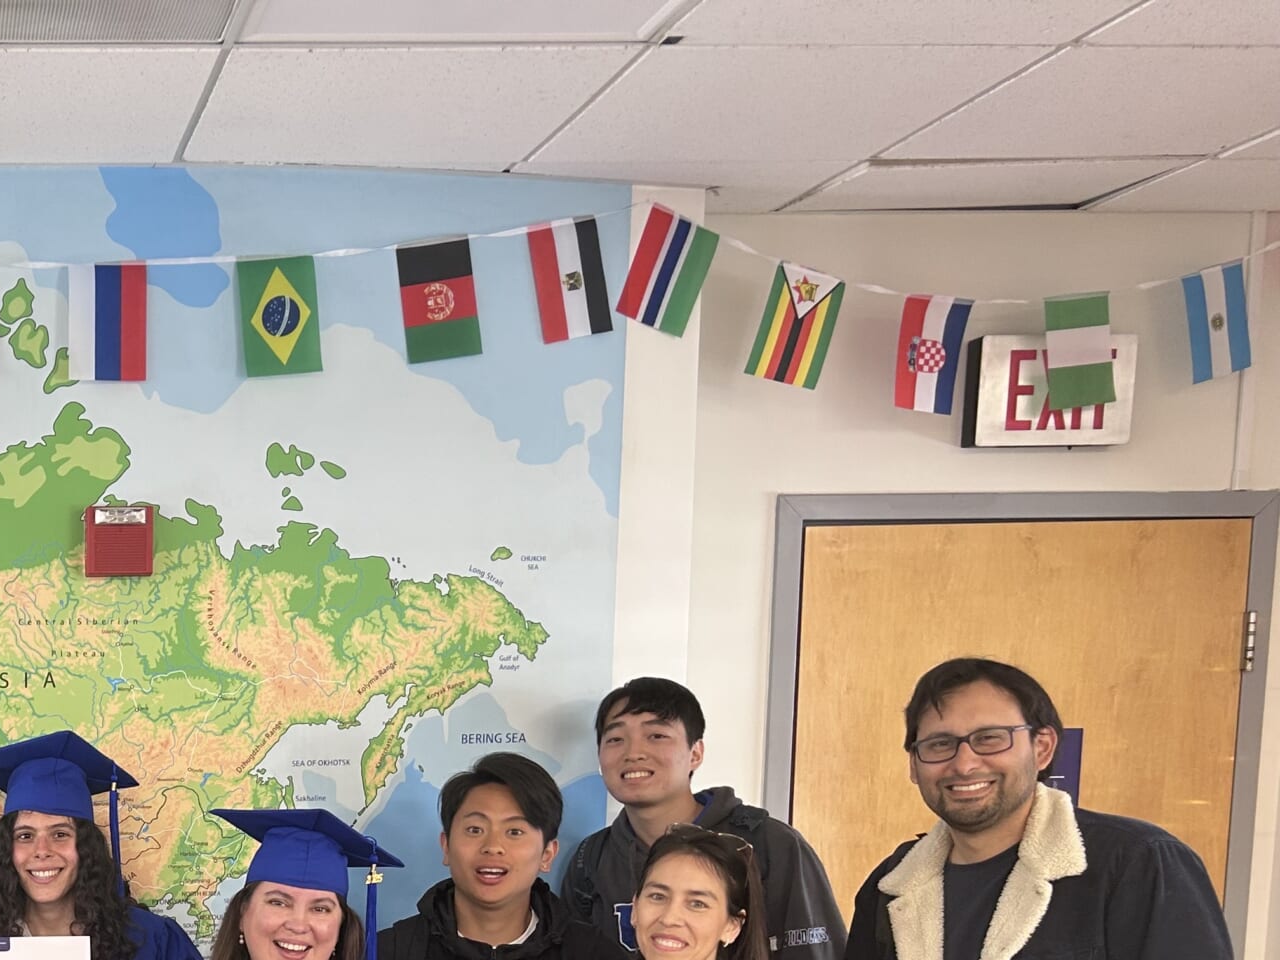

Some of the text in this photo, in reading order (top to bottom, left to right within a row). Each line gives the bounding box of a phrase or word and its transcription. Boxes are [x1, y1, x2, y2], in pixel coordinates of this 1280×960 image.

[1004, 348, 1117, 431] EX
[469, 565, 504, 588] Long Strait
[18, 618, 71, 626] Central
[205, 590, 258, 670] Verkhoyansk Range
[357, 660, 397, 695] Kolyma Range
[447, 680, 466, 691] Range
[265, 720, 283, 741] Range
[461, 732, 527, 744] BERING SEA
